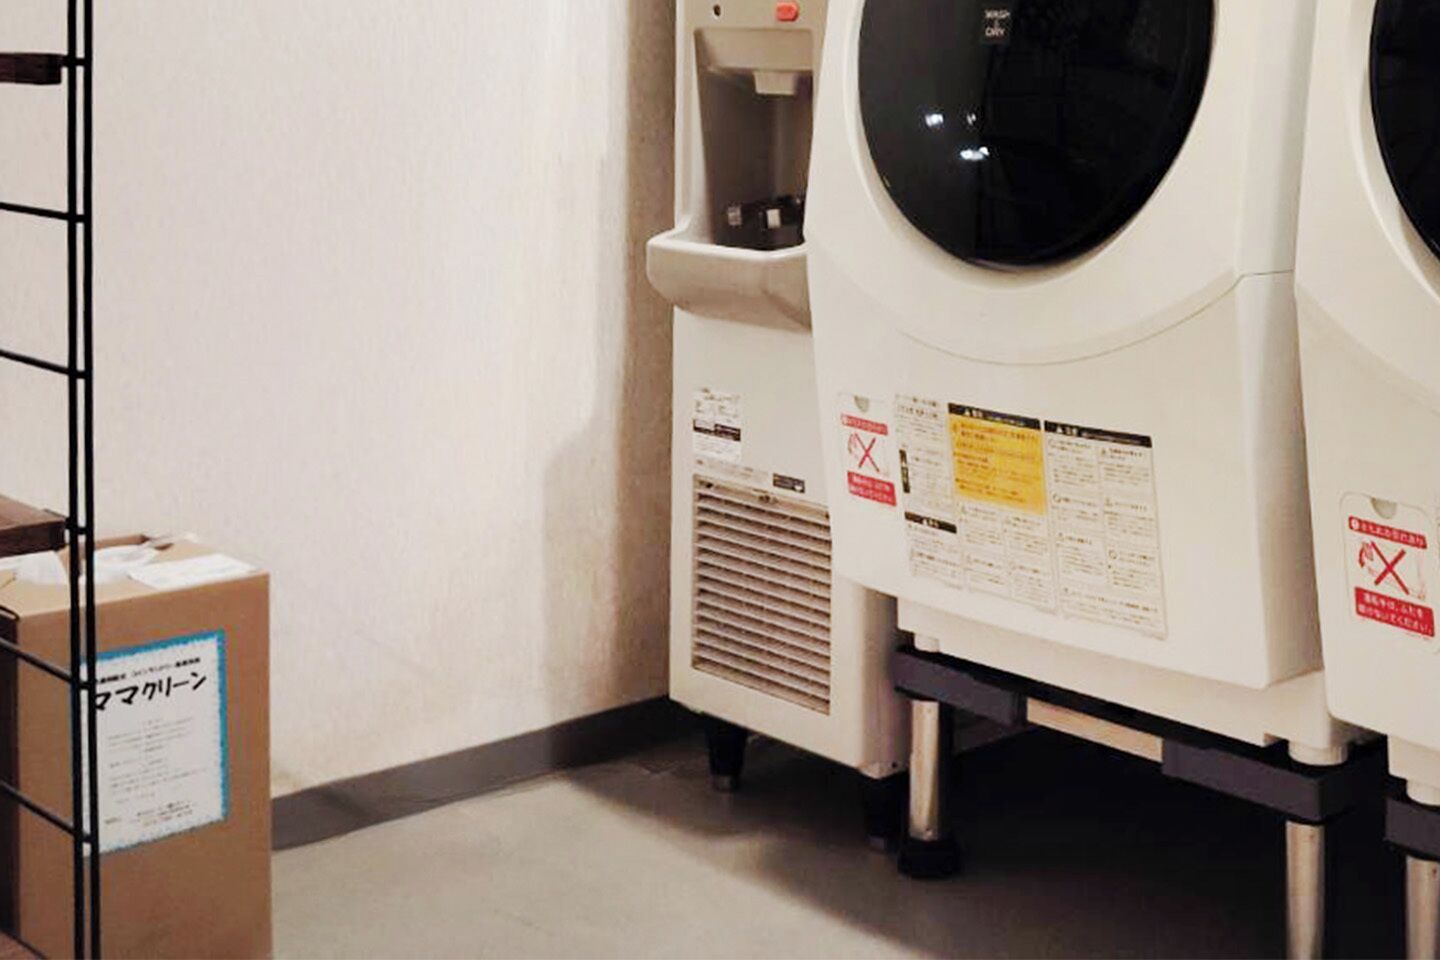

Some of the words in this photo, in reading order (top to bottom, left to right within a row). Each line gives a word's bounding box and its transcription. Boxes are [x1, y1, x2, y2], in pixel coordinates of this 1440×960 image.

[95, 671, 207, 711] ママクリーン
